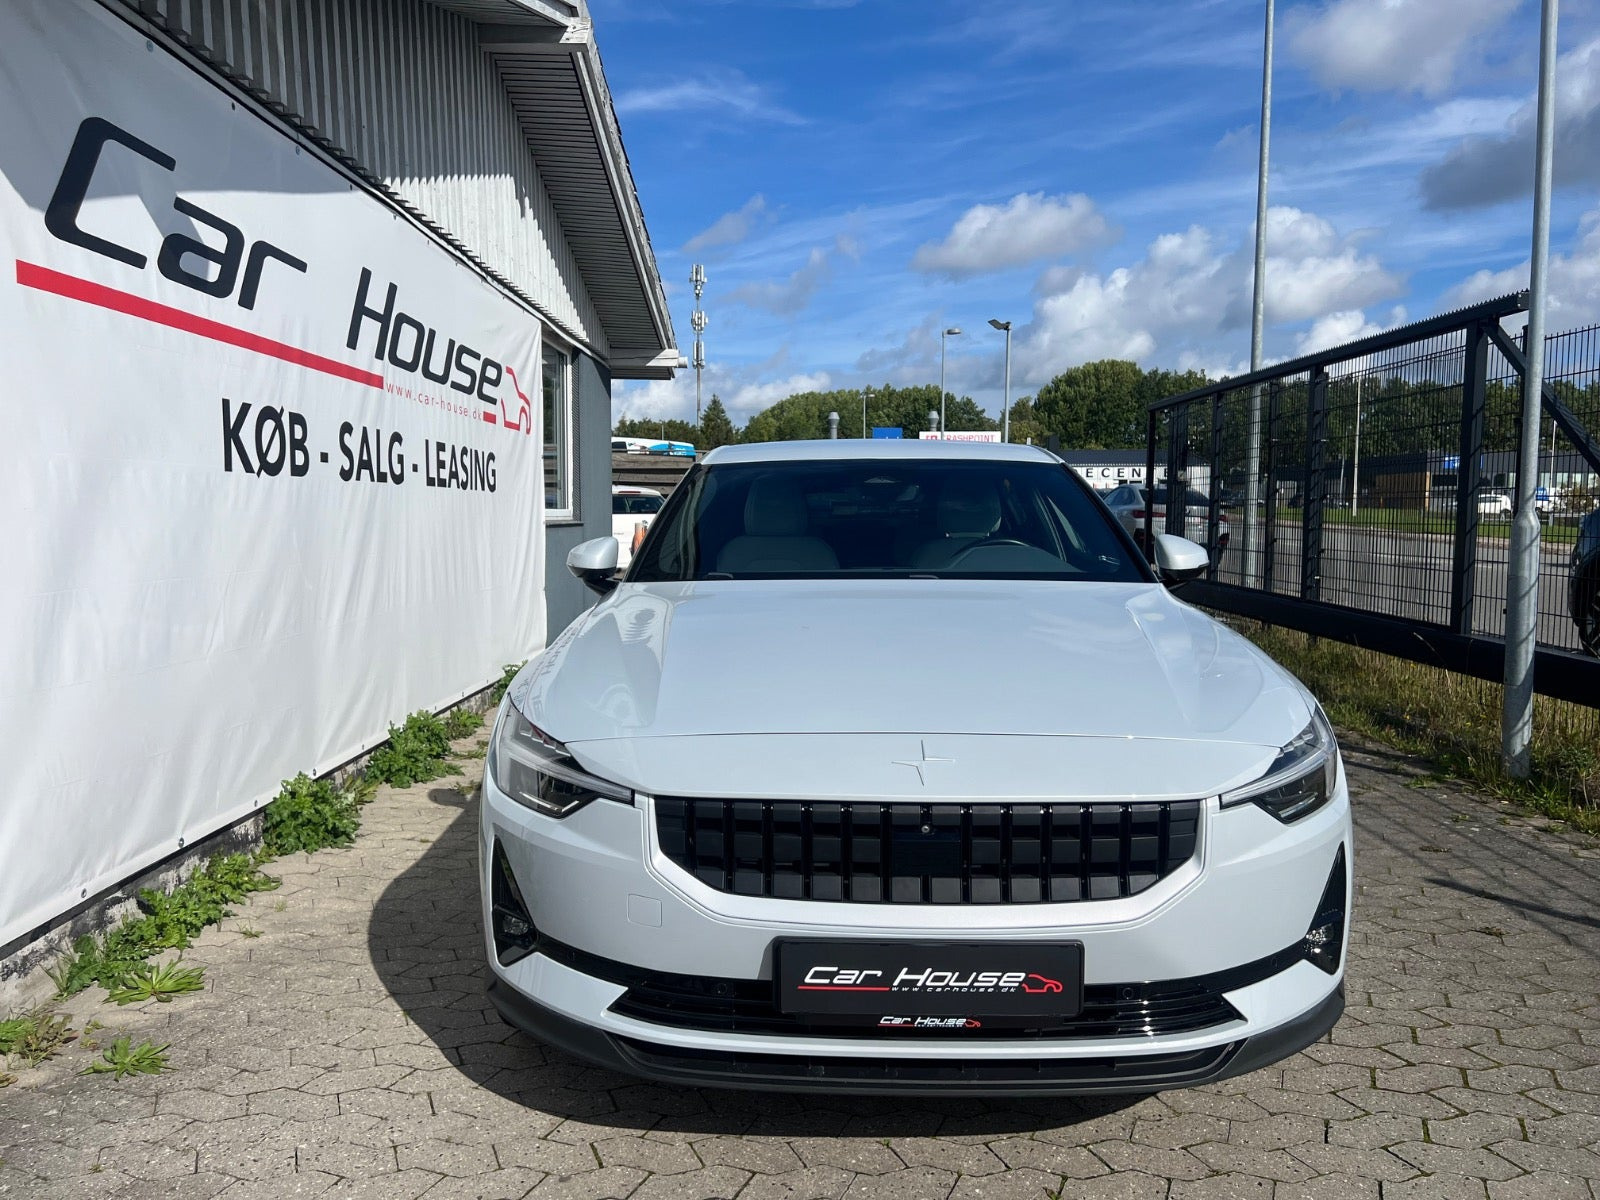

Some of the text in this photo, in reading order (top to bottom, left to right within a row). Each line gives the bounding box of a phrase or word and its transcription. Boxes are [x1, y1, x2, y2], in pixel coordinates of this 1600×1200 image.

[44, 116, 502, 406] Car House
[386, 383, 482, 421] www.car-house.dk
[222, 398, 310, 479] KØB
[339, 421, 404, 486] SALG
[425, 438, 497, 493] LEASING
[942, 434, 995, 443] RASHPOINT
[804, 966, 1026, 987] Car House
[880, 1016, 966, 1025] Car House
